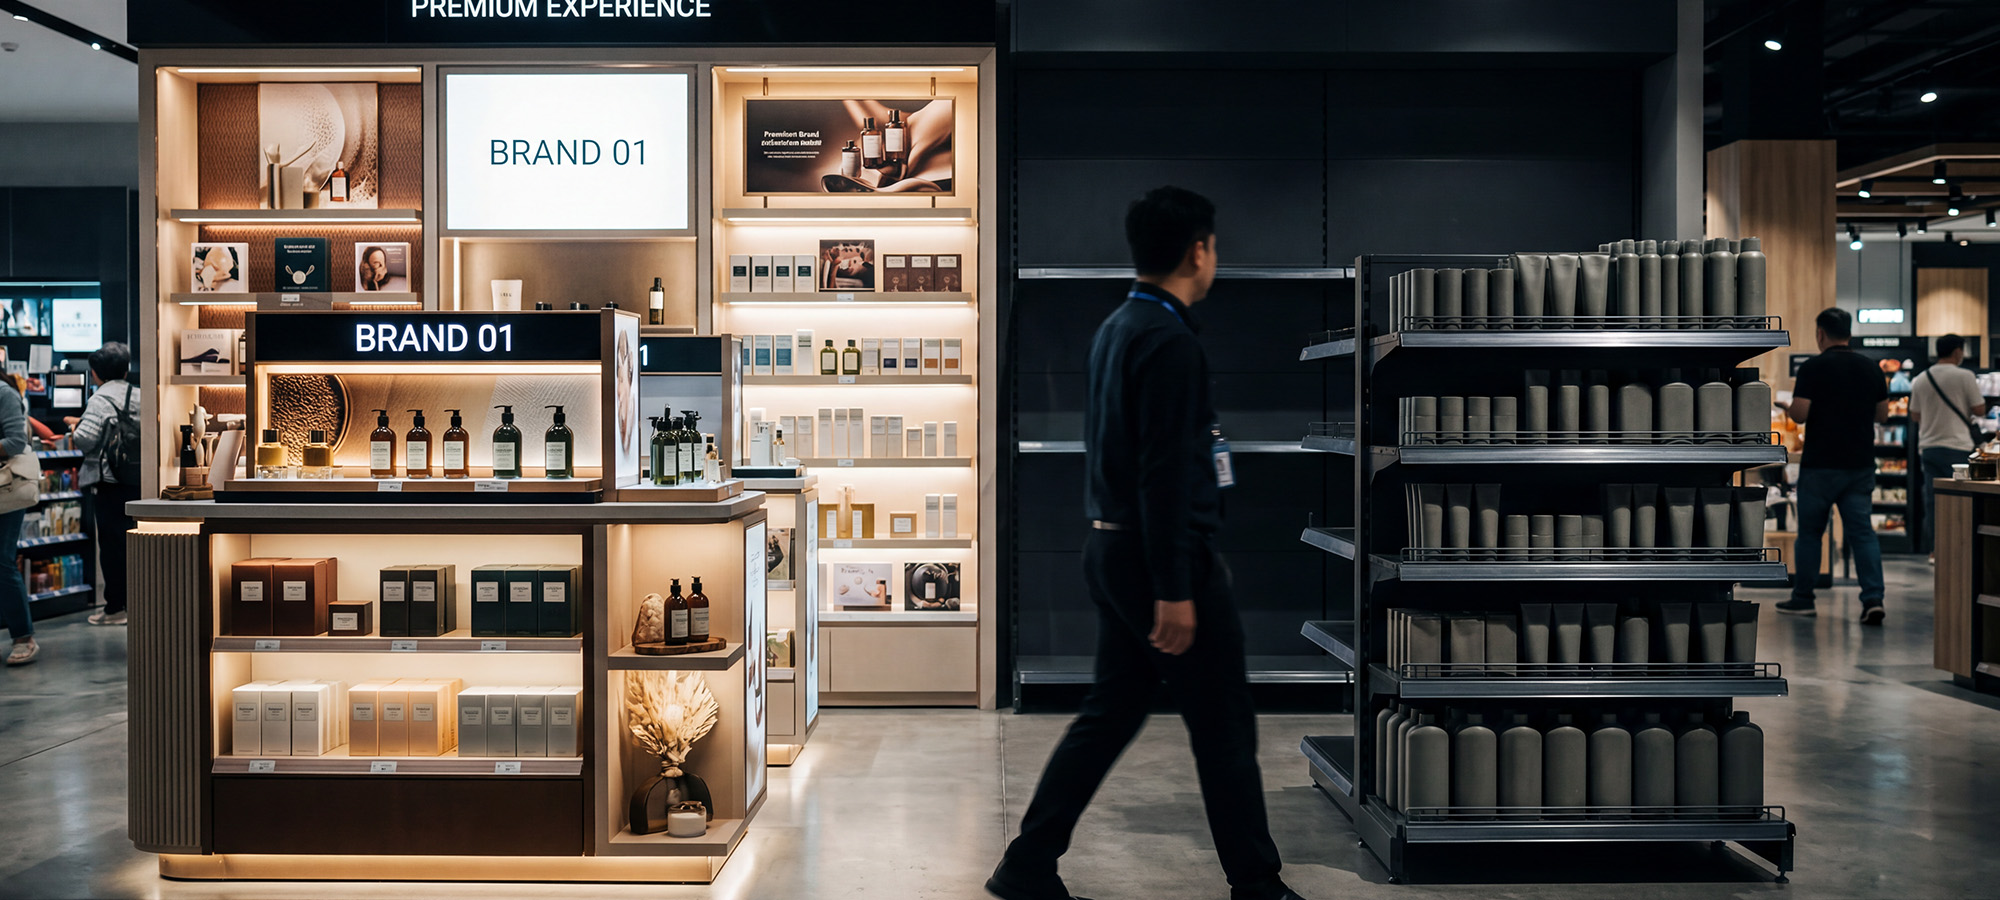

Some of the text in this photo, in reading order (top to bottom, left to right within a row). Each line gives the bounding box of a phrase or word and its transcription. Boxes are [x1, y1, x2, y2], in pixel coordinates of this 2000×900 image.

[411, 0, 712, 18] PREMIUM EXPERIENCE
[490, 139, 644, 166] BRAND 01
[356, 324, 512, 352] BRAND 01
